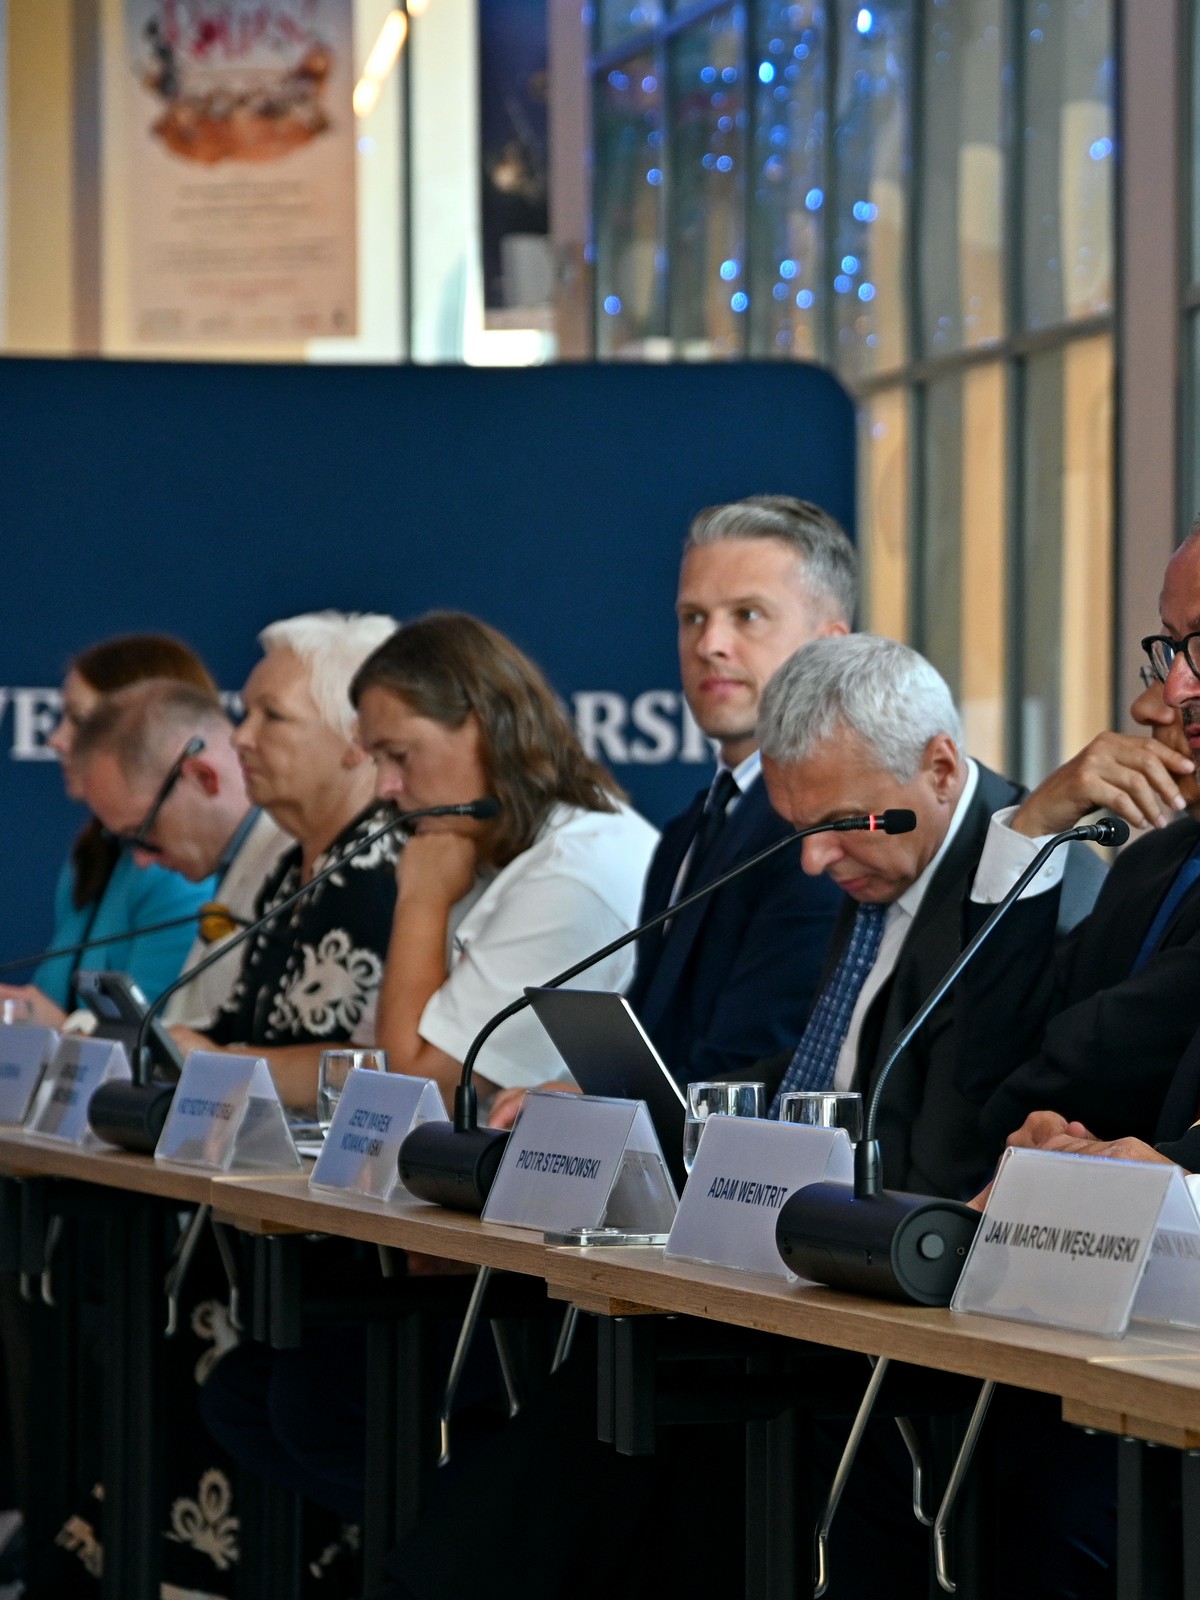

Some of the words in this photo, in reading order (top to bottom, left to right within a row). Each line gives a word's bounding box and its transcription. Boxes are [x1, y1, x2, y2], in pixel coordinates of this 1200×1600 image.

[516, 1149, 545, 1171] PIOTR
[541, 1153, 601, 1179] STEPNOWSKI
[707, 1177, 739, 1200] ADAM
[737, 1181, 788, 1208] WEINTRIT
[985, 1221, 1012, 1244] JAN
[1010, 1223, 1061, 1251] MARCIN
[1060, 1229, 1141, 1262] WĘSŁAWSKI
